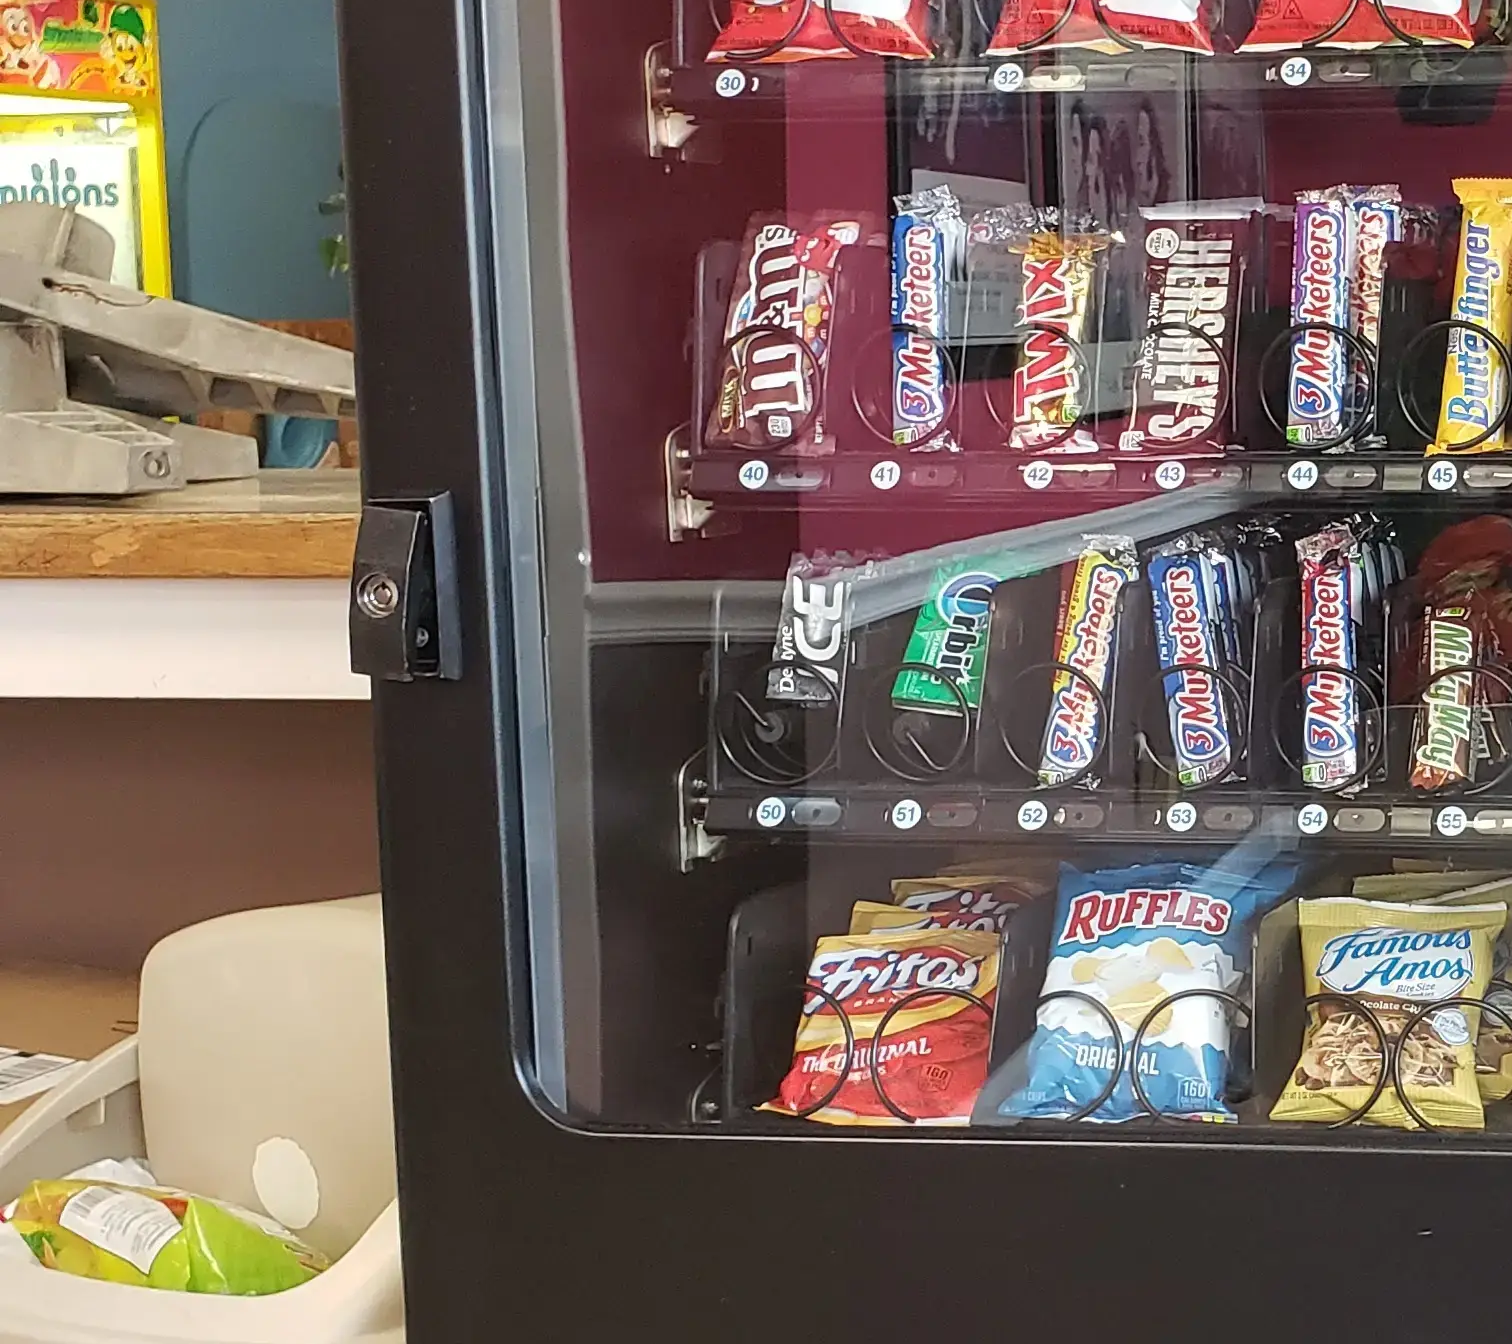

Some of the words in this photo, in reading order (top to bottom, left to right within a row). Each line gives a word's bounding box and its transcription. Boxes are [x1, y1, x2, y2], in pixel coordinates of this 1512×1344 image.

[997, 70, 1020, 86] 32
[1284, 63, 1308, 79] 34
[719, 76, 742, 92] 30
[900, 225, 934, 388] Muketeers
[1148, 290, 1161, 317] MILK
[1295, 215, 1333, 382] Muketeers
[1447, 218, 1501, 429] Buttefinger
[1013, 257, 1078, 423] TWIX
[721, 377, 739, 419] MILK
[902, 389, 929, 414] 3
[1297, 384, 1323, 409] 3
[742, 465, 765, 482] 40
[874, 466, 897, 482] 41
[1026, 466, 1050, 483] 42
[1159, 466, 1182, 483] 43
[1291, 466, 1315, 483] 44
[1431, 467, 1454, 484] 45
[792, 574, 845, 685] ICE
[1155, 619, 1168, 644] proud
[1056, 568, 1123, 737] Muketeers
[1168, 567, 1216, 727] Muketeers
[1307, 570, 1343, 724] Muketeer
[1053, 733, 1081, 761] 3
[1186, 731, 1213, 751] 3
[1311, 726, 1336, 748] 3
[1416, 699, 1473, 771] Way
[760, 804, 783, 820] 50
[895, 806, 917, 822] 51
[1021, 808, 1044, 824] 52
[1169, 809, 1192, 825] 53
[1301, 811, 1324, 827] 54
[1441, 813, 1464, 829] 55
[1063, 891, 1230, 941] RUFFLES
[1315, 928, 1472, 977] Famous
[804, 949, 987, 1015] Fritos
[1343, 956, 1474, 992] Amos
[1396, 984, 1415, 994] Bite
[1416, 983, 1436, 991] Size
[1075, 1045, 1160, 1075] ORIGIAL
[1184, 1080, 1206, 1097] 160
